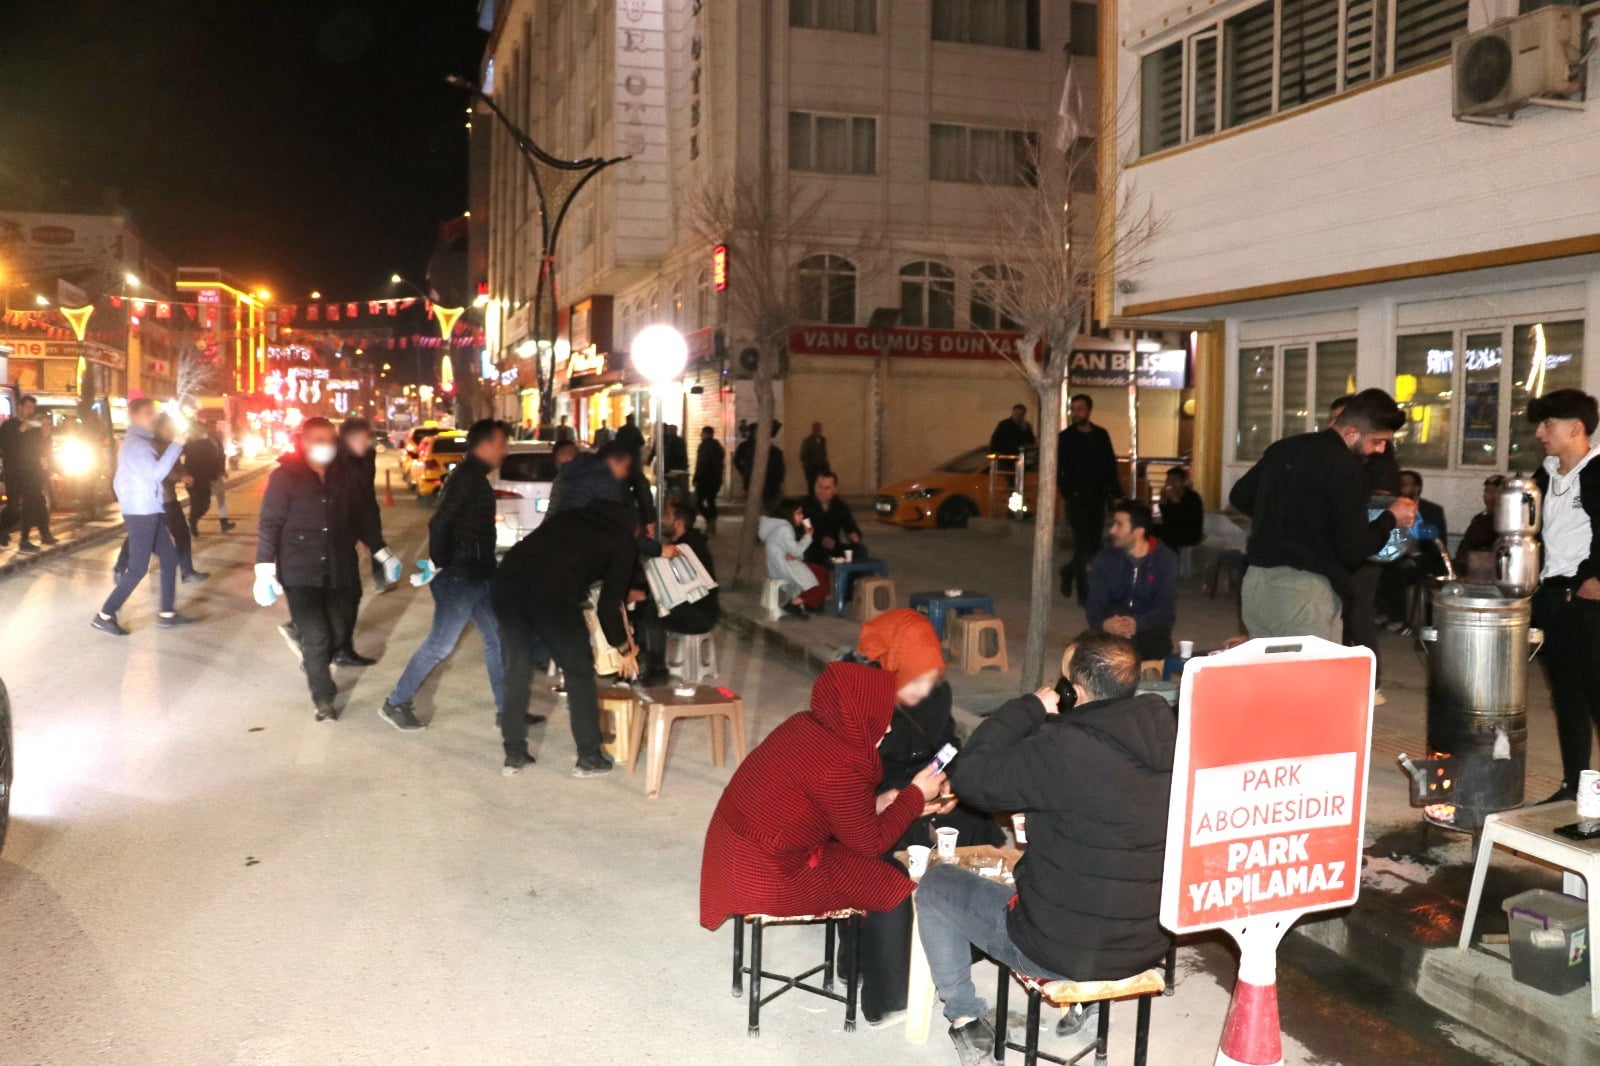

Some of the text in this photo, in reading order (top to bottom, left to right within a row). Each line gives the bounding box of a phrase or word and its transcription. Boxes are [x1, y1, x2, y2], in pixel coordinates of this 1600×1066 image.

[803, 331, 848, 348] VAN
[1071, 352, 1106, 370] AN
[1242, 764, 1303, 791] PARK
[1196, 791, 1345, 836] ABONESİDİR
[1227, 833, 1310, 872] PARK
[1189, 861, 1345, 912] YAPILAMAZ
